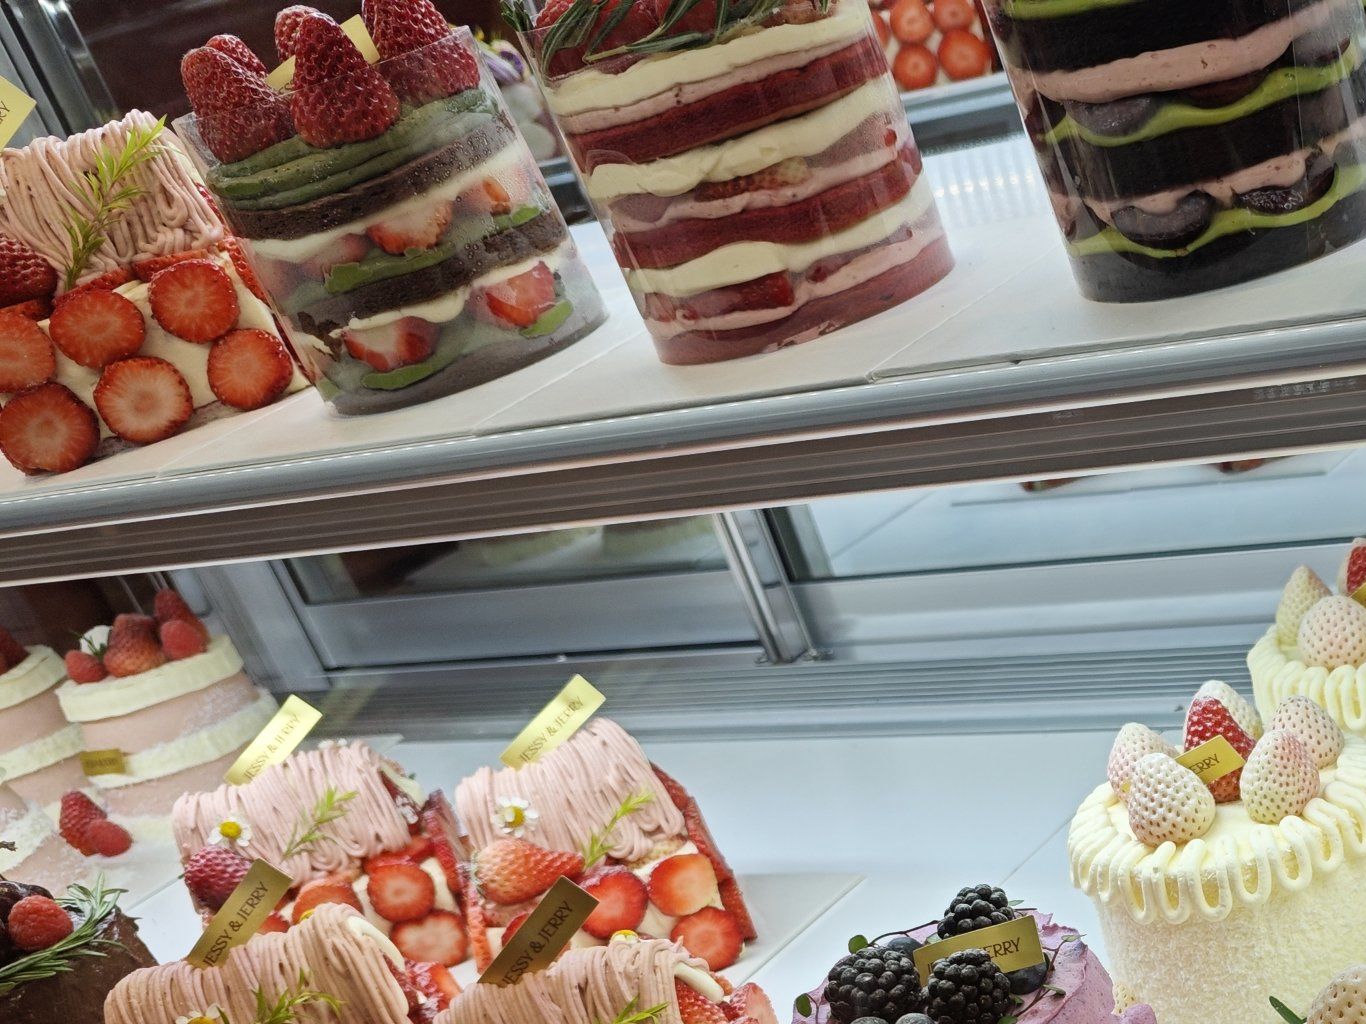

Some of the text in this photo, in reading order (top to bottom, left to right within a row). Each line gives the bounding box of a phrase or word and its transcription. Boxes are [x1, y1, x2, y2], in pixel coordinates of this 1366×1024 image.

[1189, 754, 1219, 774] ERRY
[202, 881, 269, 967] JESSY & JERRY
[502, 900, 573, 984] JESSY & JERRY
[980, 937, 1020, 959] ERRY
